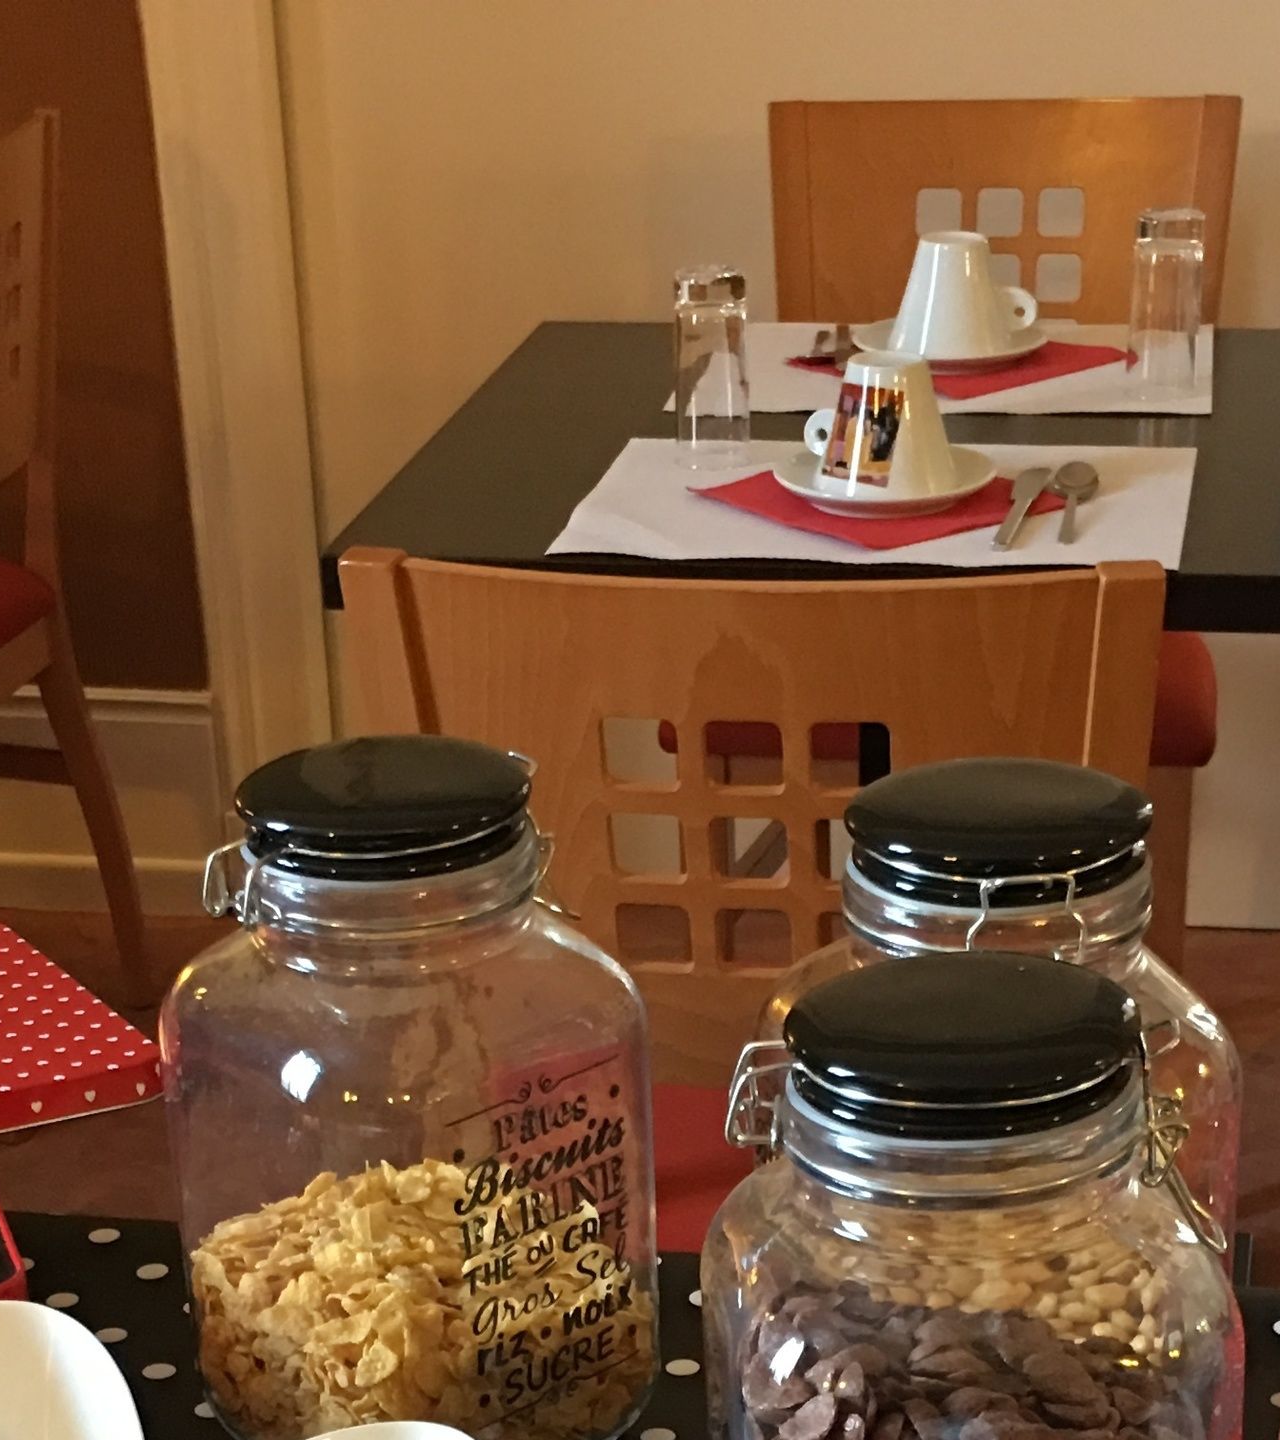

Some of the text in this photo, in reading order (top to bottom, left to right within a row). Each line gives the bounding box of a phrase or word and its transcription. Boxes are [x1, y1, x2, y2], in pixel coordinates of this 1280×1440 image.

[454, 1117, 626, 1215] Biscuits
[460, 1156, 625, 1260] FARINE
[572, 1232, 629, 1294] Sel
[477, 1282, 634, 1377] riz noix
[504, 1325, 615, 1406] SUCRE
